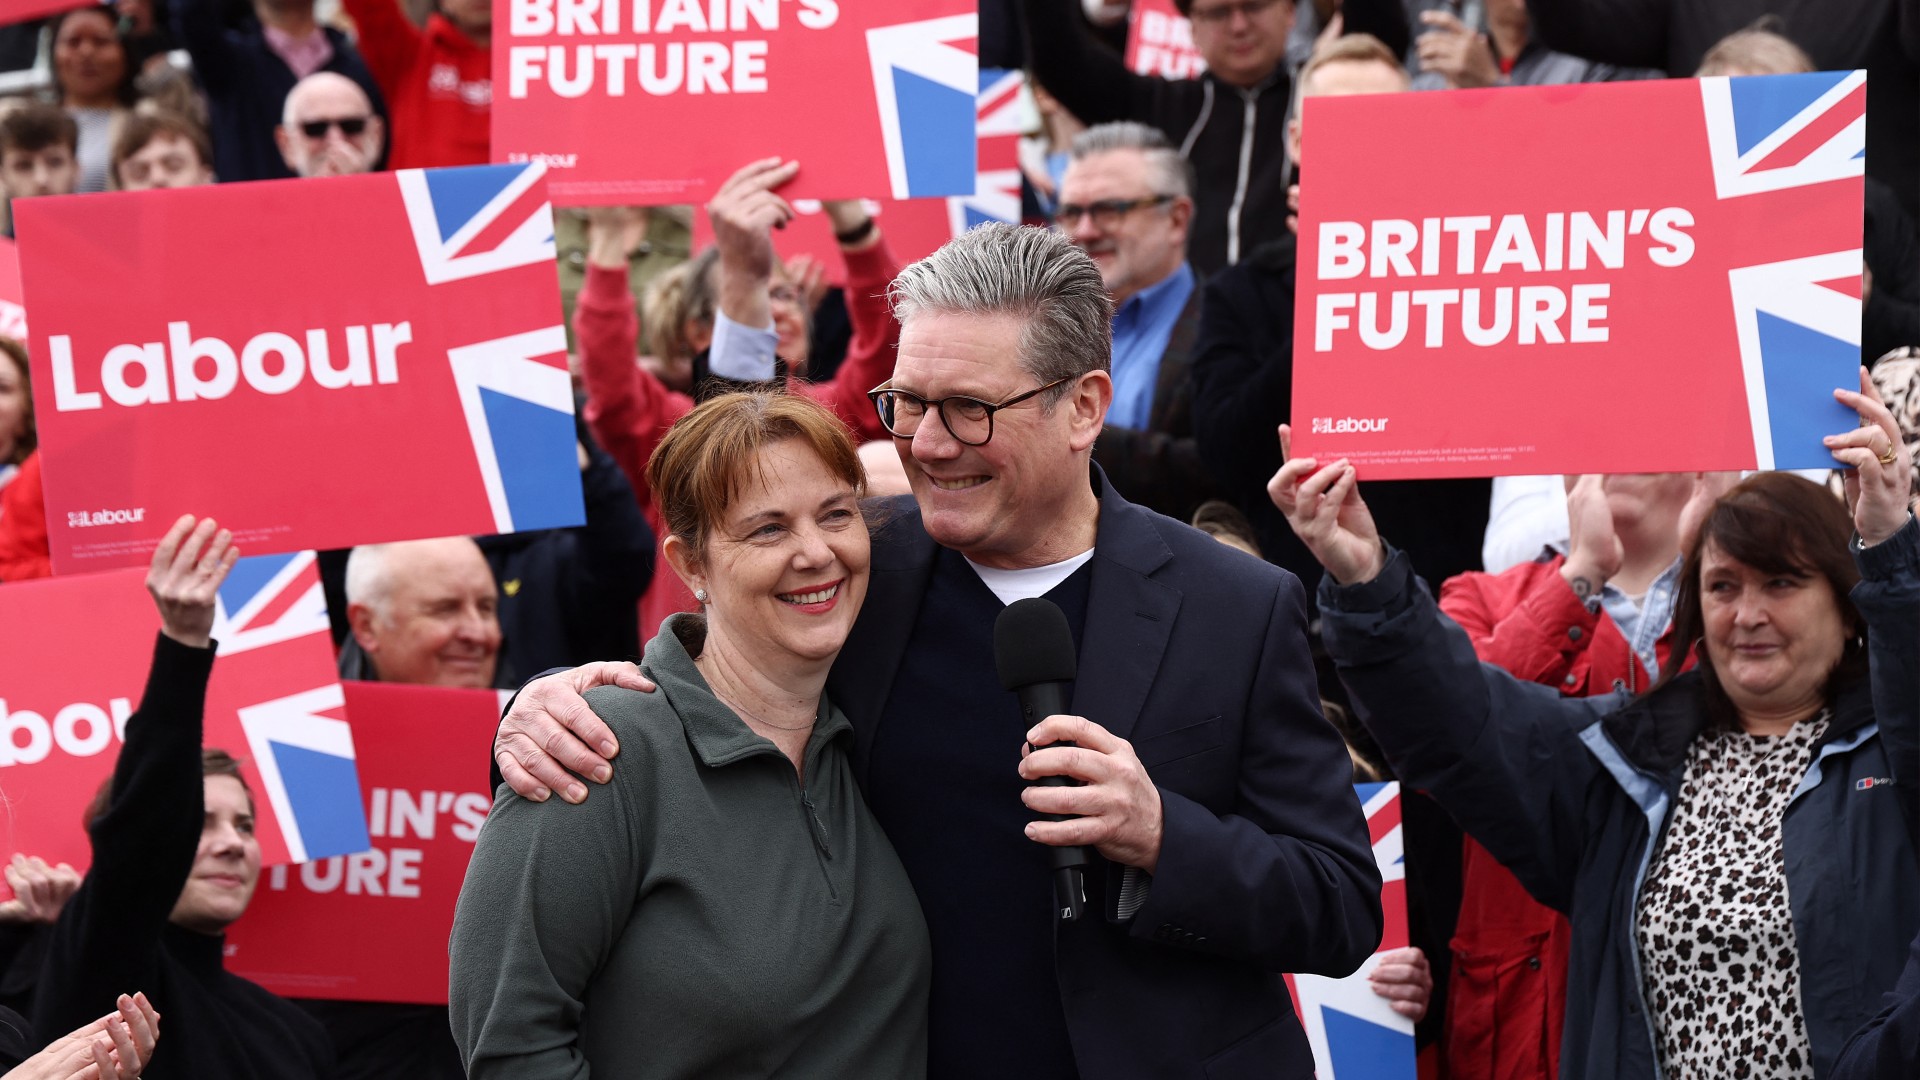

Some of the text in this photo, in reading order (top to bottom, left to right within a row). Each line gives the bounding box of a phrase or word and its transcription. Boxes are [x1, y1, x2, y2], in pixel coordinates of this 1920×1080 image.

[509, 0, 841, 37] BRITAINS
[508, 40, 769, 99] FUTURE
[1317, 206, 1696, 280] BRITAIN'S
[1314, 283, 1611, 353] FUTURE
[48, 320, 413, 412] Labour
[1327, 416, 1389, 434] Labour
[82, 507, 146, 527] Labour
